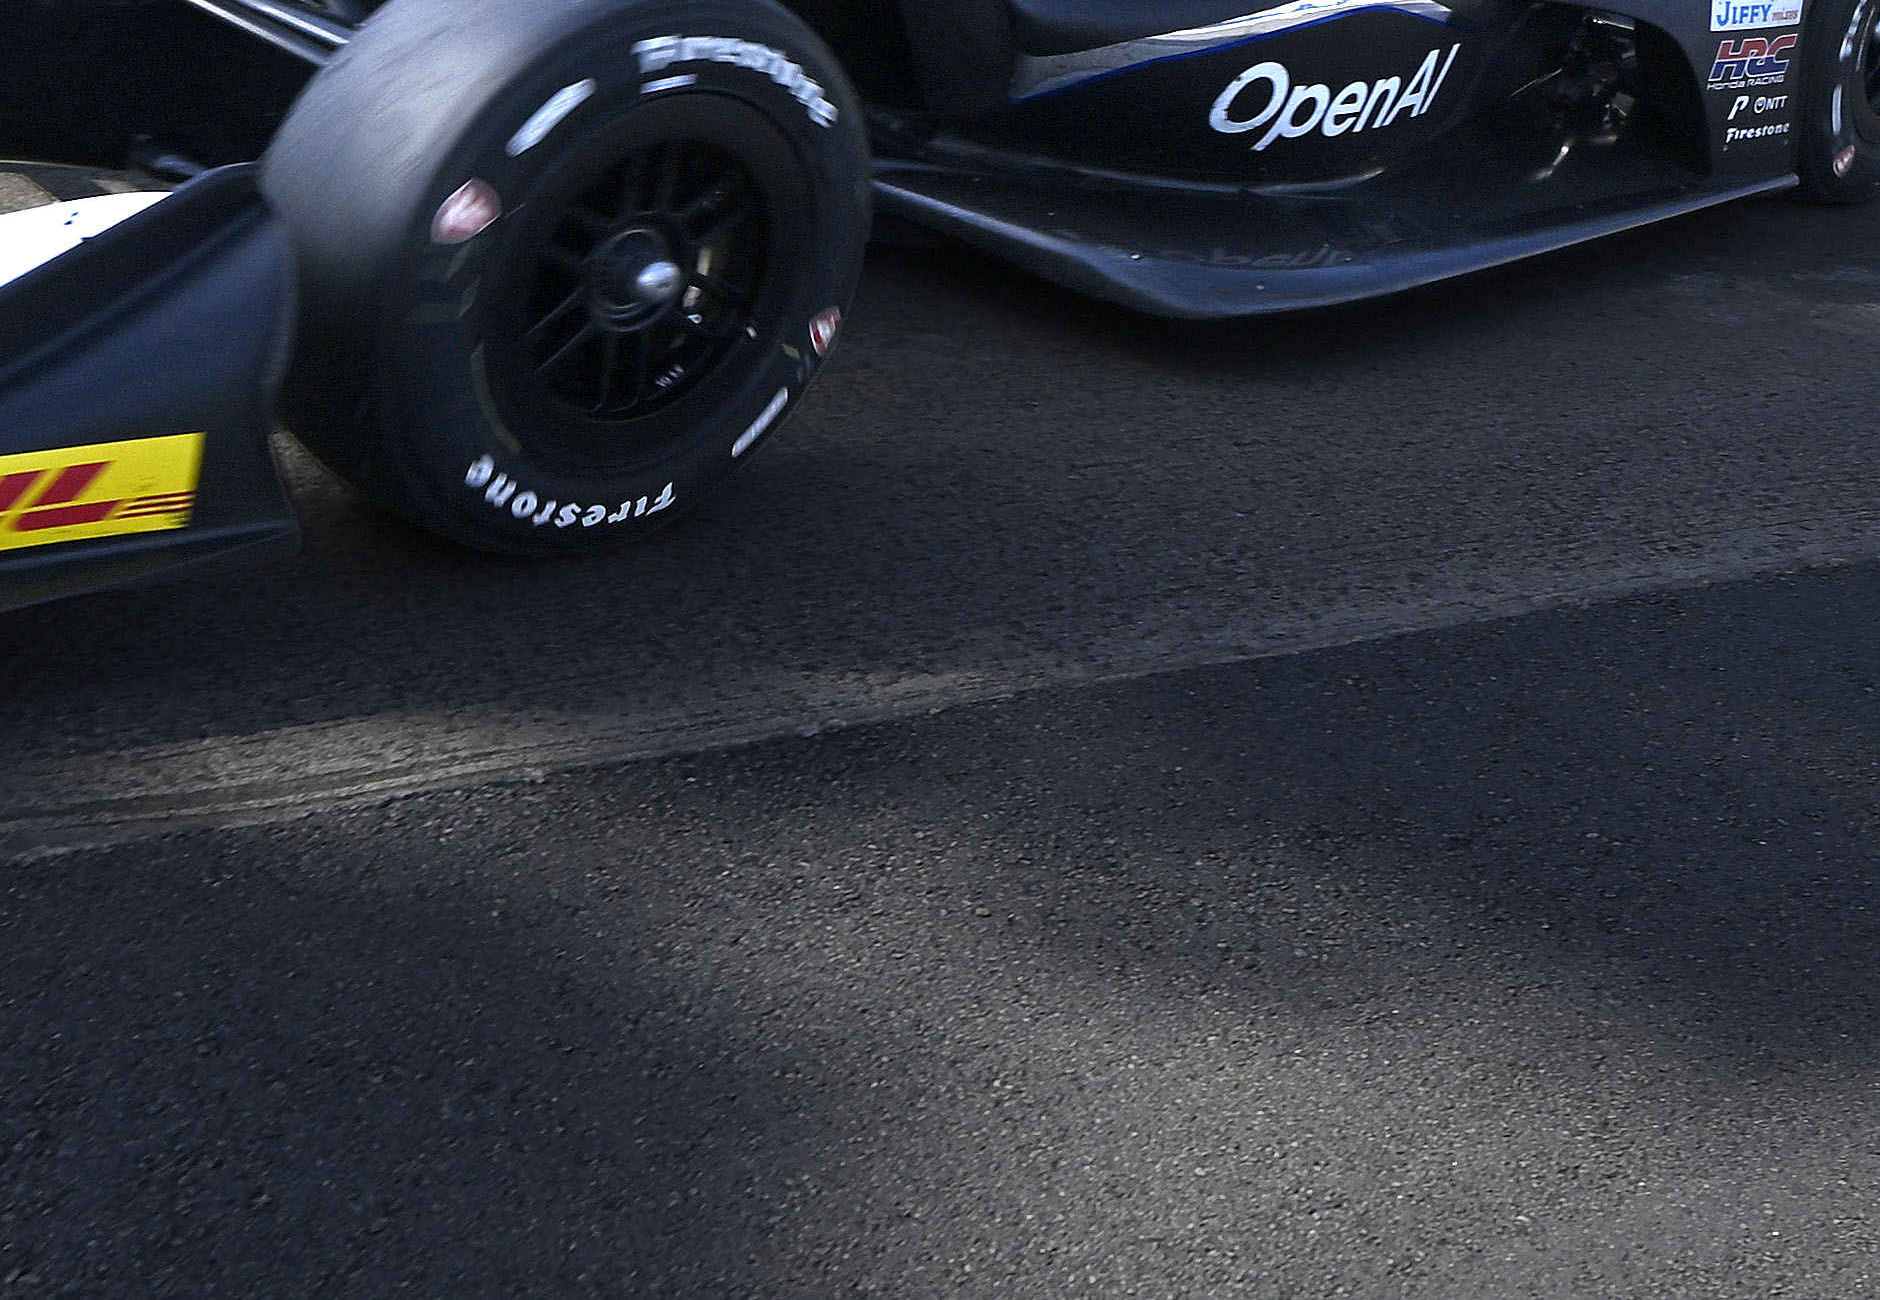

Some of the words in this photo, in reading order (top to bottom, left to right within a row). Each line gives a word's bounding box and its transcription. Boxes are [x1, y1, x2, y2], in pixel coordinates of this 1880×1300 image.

[1716, 0, 1773, 28] JIFFY
[1707, 32, 1800, 83] HRC
[1209, 42, 1462, 152] OpenAI
[1725, 122, 1791, 145] Firestone
[463, 453, 677, 529] Firestone
